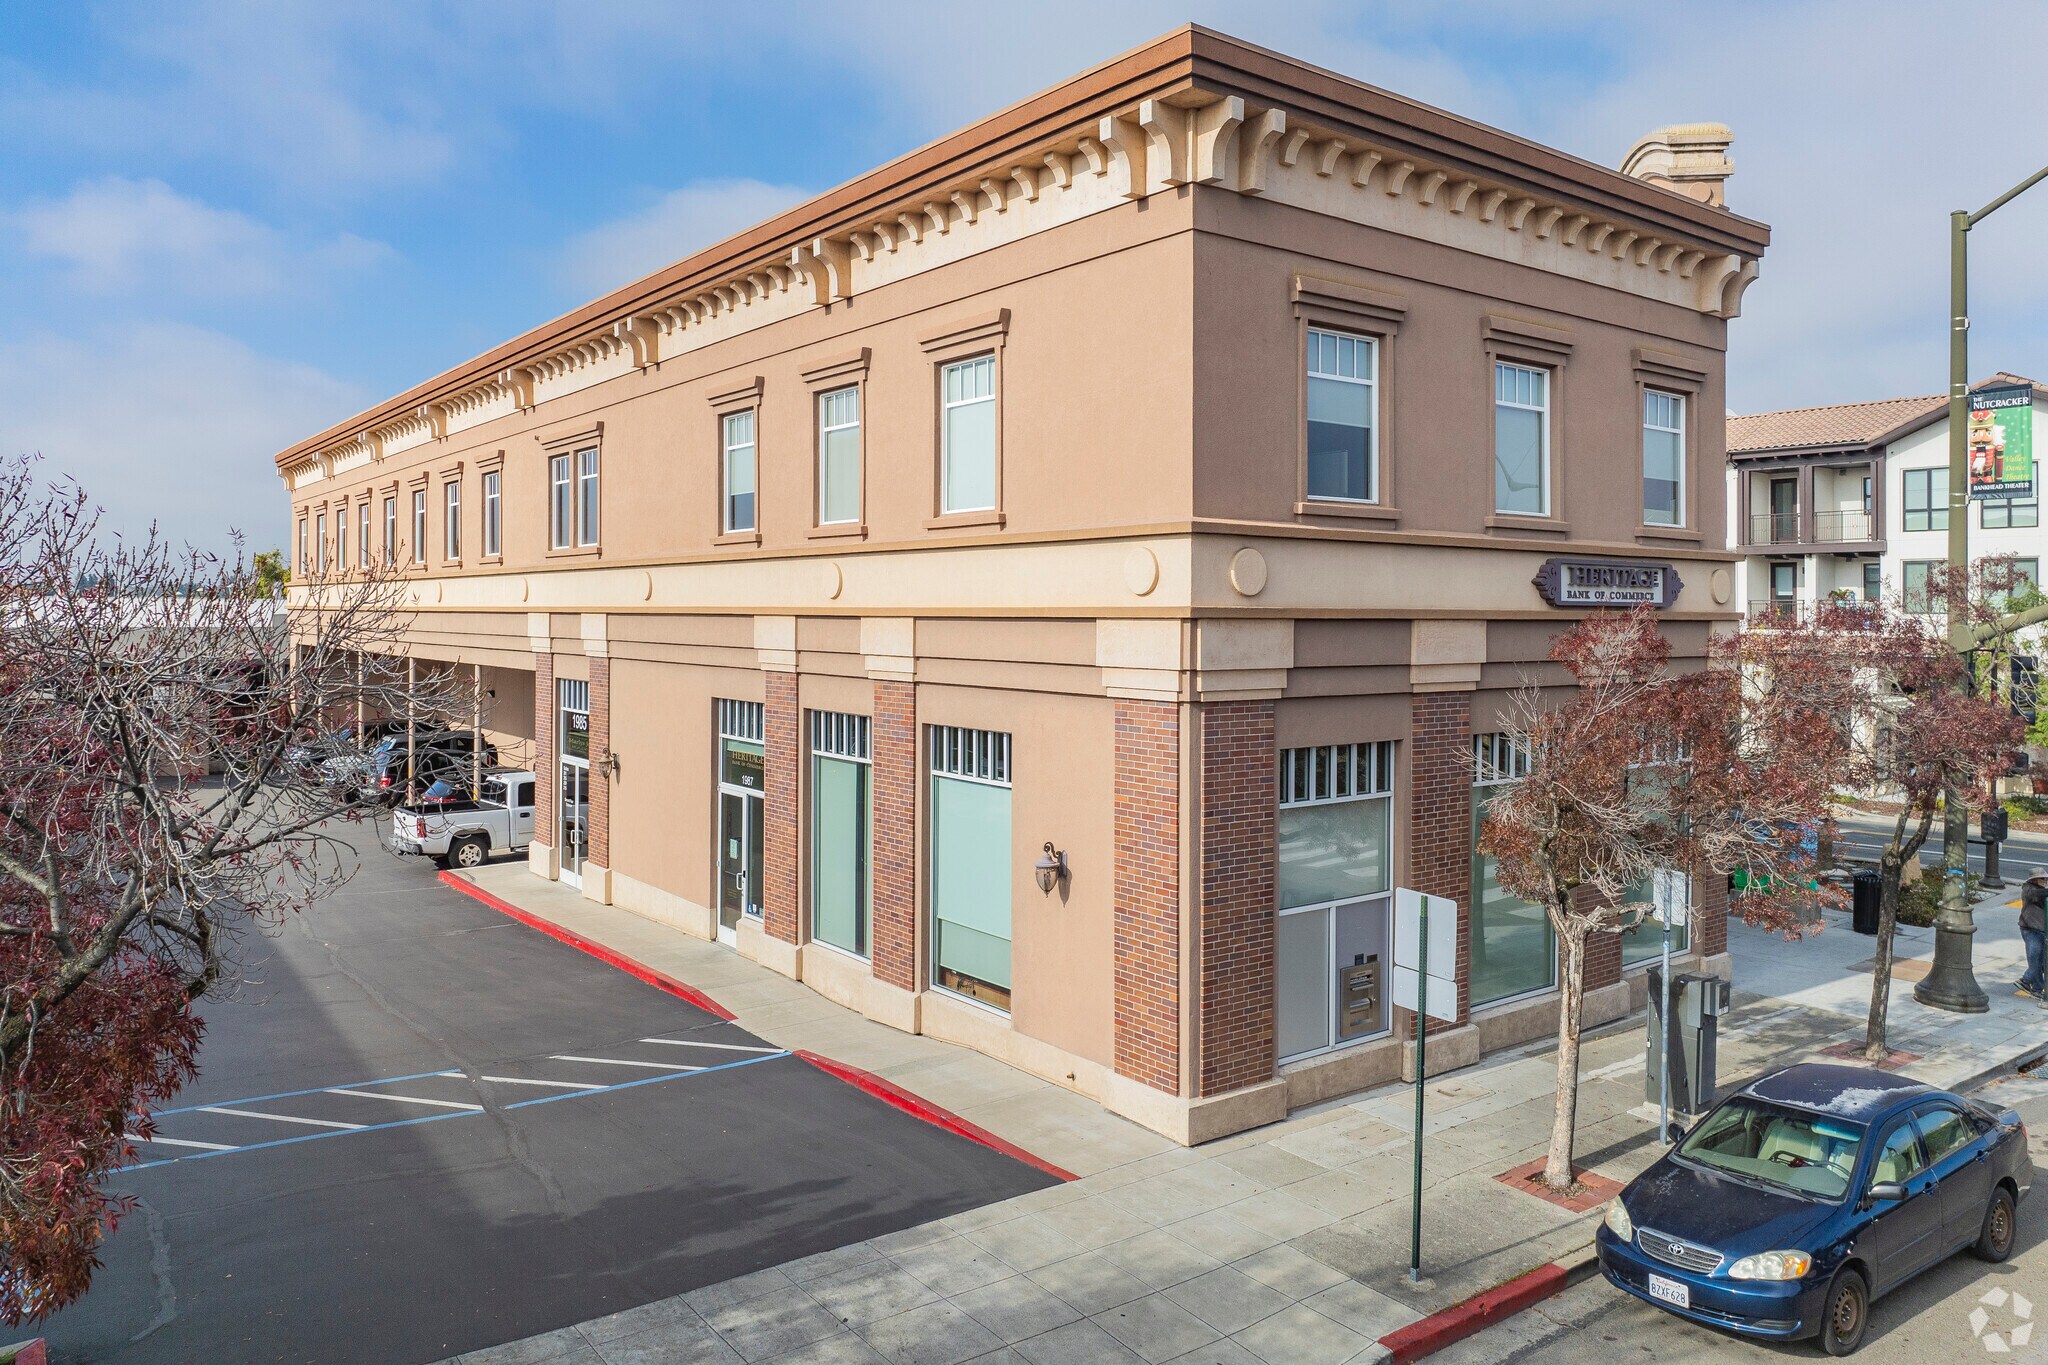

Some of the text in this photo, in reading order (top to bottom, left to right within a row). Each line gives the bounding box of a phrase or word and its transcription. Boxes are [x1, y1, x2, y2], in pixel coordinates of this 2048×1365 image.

[1973, 397, 2029, 409] NUTCRACKER
[1567, 567, 1659, 588] HERITAGE
[1567, 590, 1654, 600] BANK OF COMMERCE
[572, 714, 588, 730] 1985
[732, 751, 764, 764] HERITAGE
[742, 775, 754, 786] 1987
